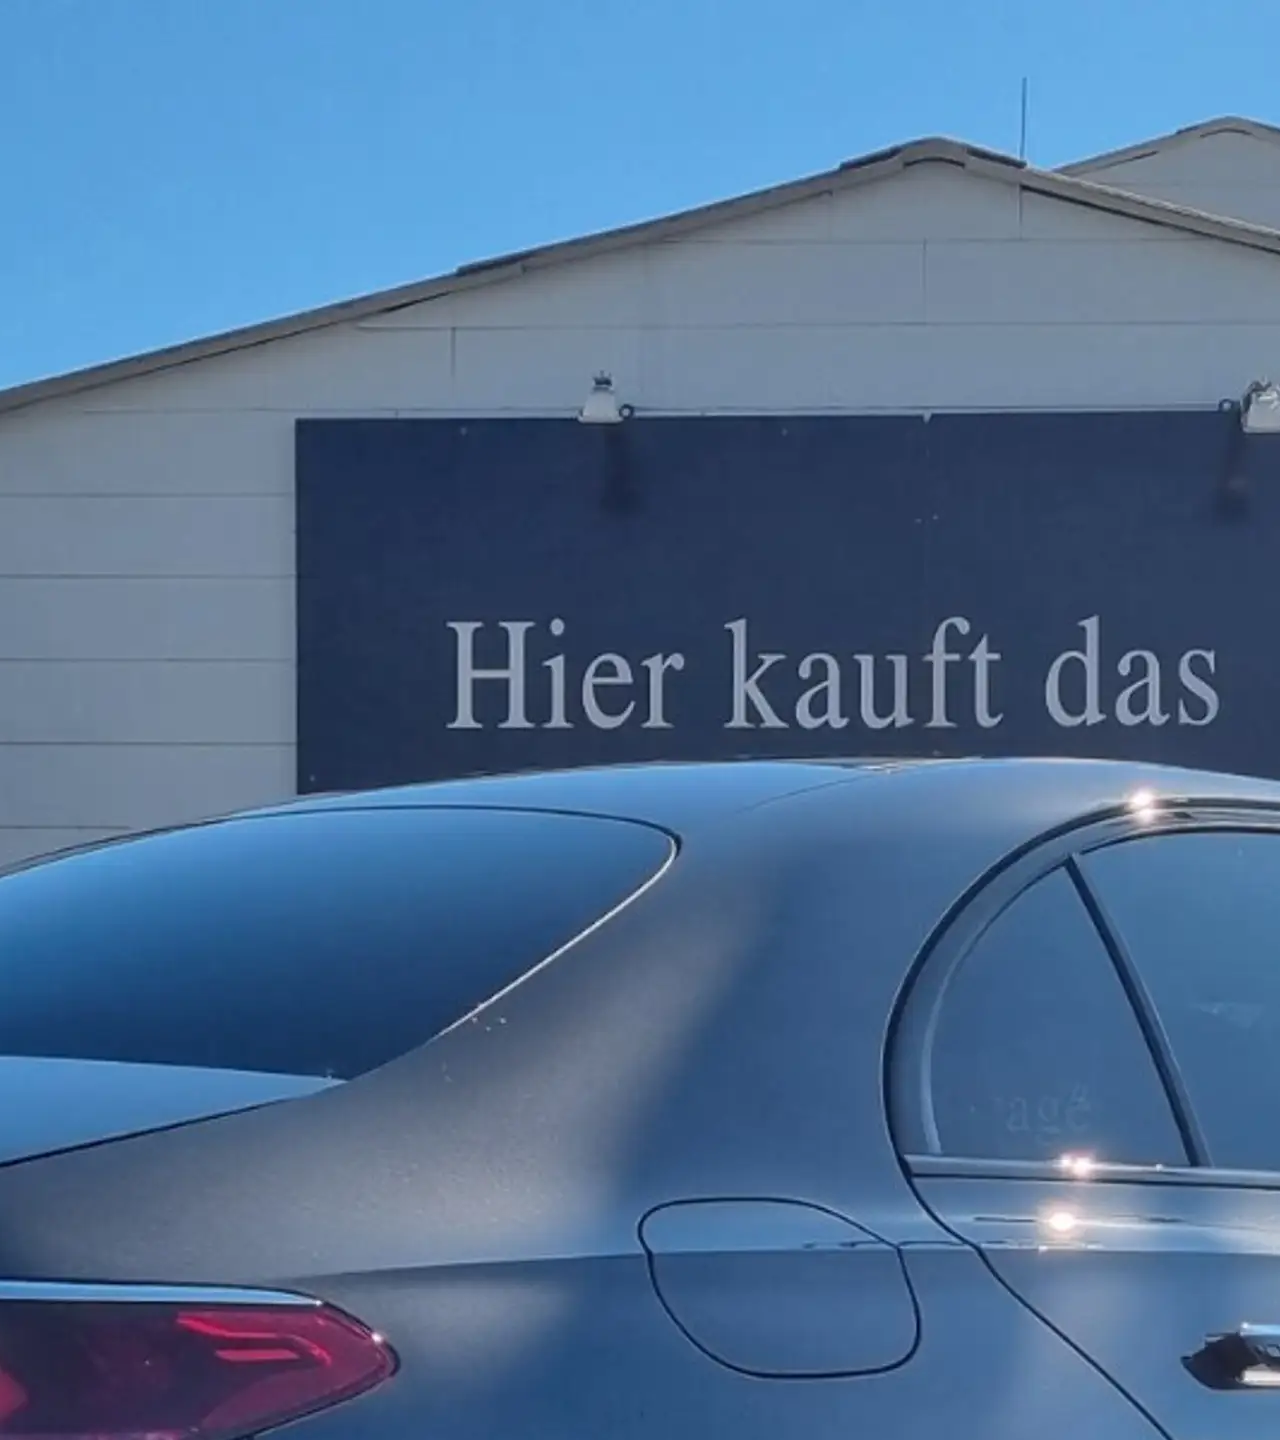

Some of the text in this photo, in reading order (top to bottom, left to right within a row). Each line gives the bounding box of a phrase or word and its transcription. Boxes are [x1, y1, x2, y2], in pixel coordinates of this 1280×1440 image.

[447, 615, 1220, 730] Hier kauft das
